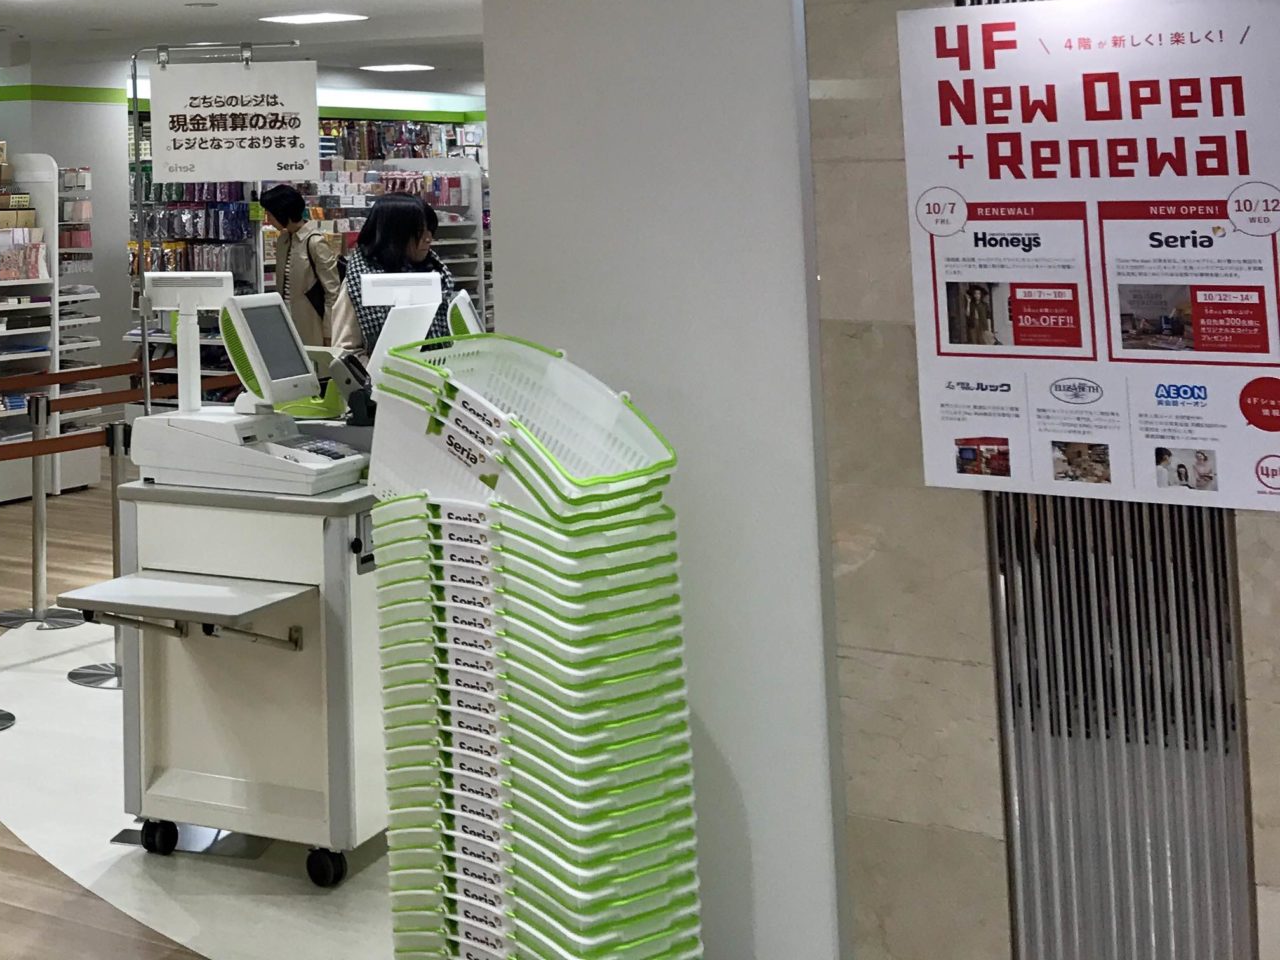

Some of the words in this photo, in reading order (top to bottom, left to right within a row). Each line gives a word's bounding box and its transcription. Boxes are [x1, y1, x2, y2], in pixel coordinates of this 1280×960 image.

[934, 21, 1017, 71] 4F
[188, 94, 285, 108] こちらのレジは、
[169, 112, 301, 132] 現金精算のみの
[172, 136, 305, 151] レジとなっております。
[276, 161, 305, 171] Seria
[925, 202, 956, 215] 10/7
[977, 207, 1035, 216] RENEWAL!
[1149, 206, 1177, 215] NEW
[1180, 205, 1219, 215] OPEN!
[1234, 199, 1280, 212] 10/12
[973, 232, 1041, 253] Honeys
[1149, 230, 1214, 249] Seria
[1155, 384, 1208, 400] AEON
[446, 434, 478, 465] Seria
